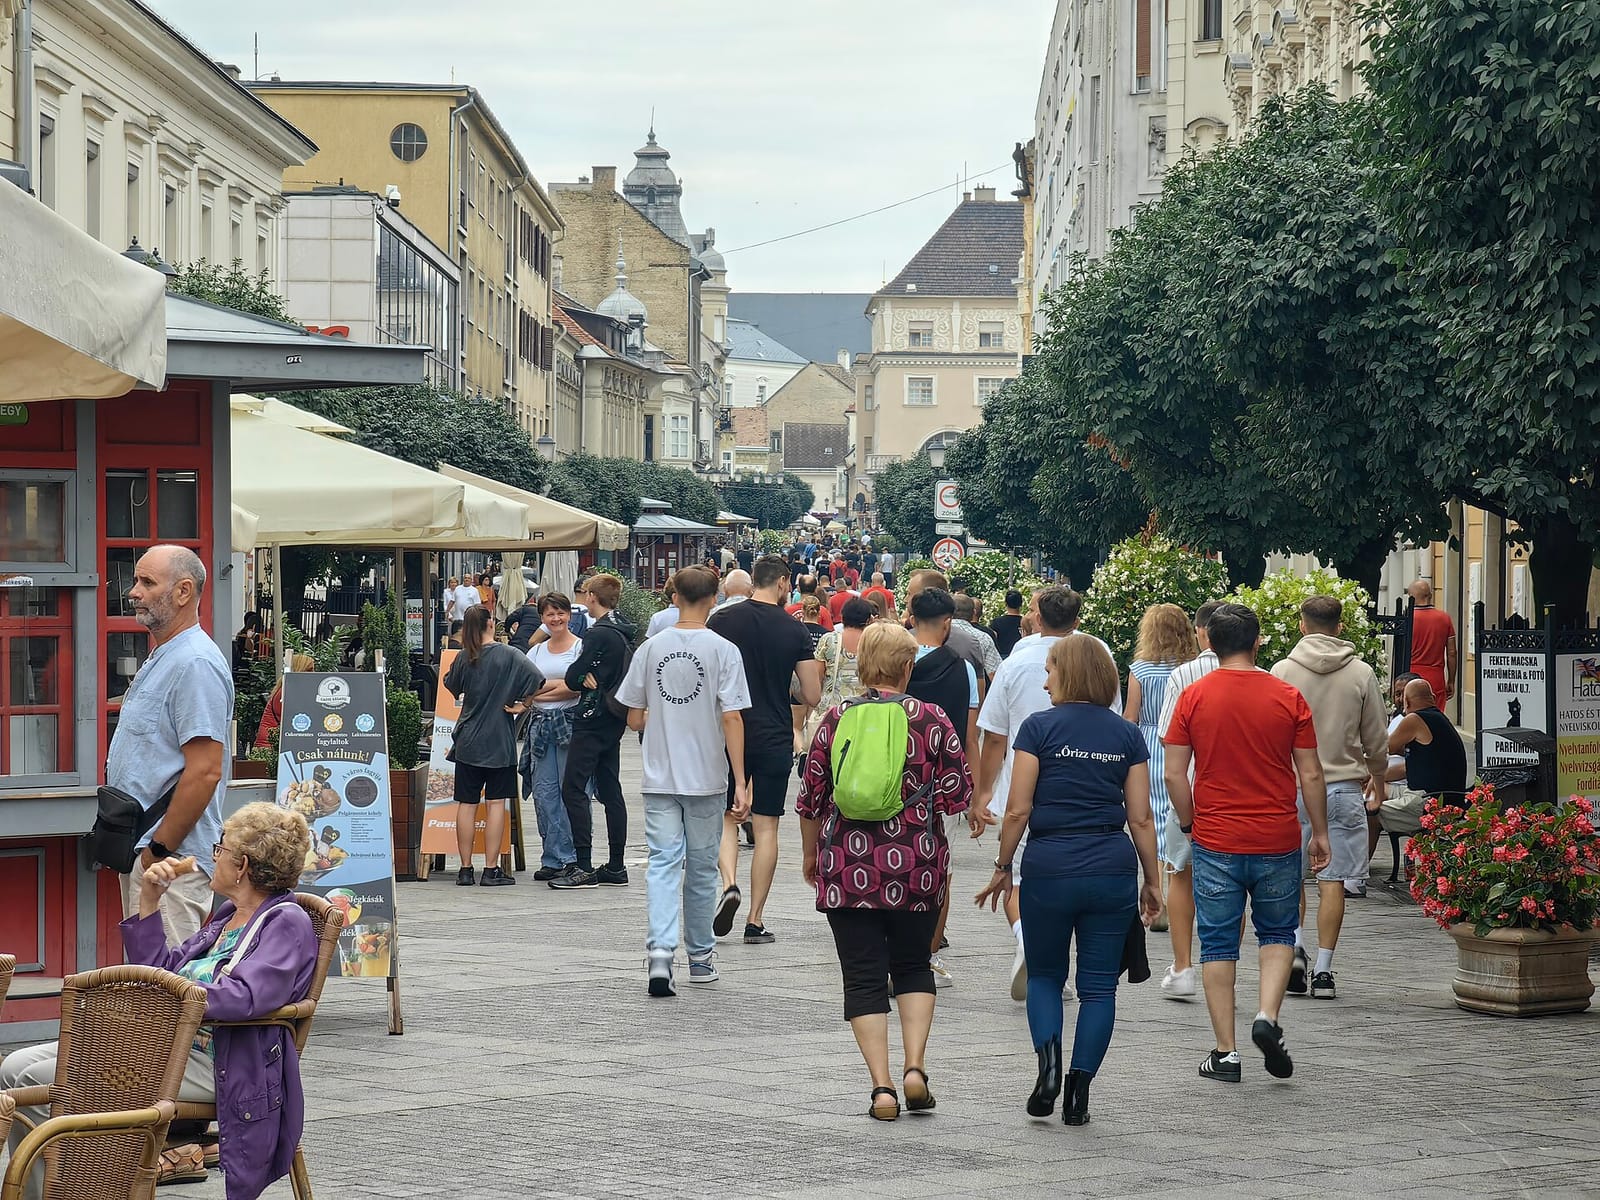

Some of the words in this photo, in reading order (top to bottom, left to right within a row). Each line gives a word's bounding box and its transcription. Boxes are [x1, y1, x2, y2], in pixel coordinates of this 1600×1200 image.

[656, 651, 705, 678] HOODEDSTAFF
[1489, 655, 1510, 666] FEKETE
[1510, 656, 1538, 666] MACSKA
[1523, 671, 1528, 679] &
[656, 679, 703, 705] HOODEDSTAFF
[1559, 710, 1585, 720] HATOS
[1586, 707, 1595, 719] ÉS
[435, 725, 453, 734] KEB
[317, 738, 349, 747] fagylaltok
[297, 748, 324, 761] Csak
[326, 748, 370, 762] nálunk!
